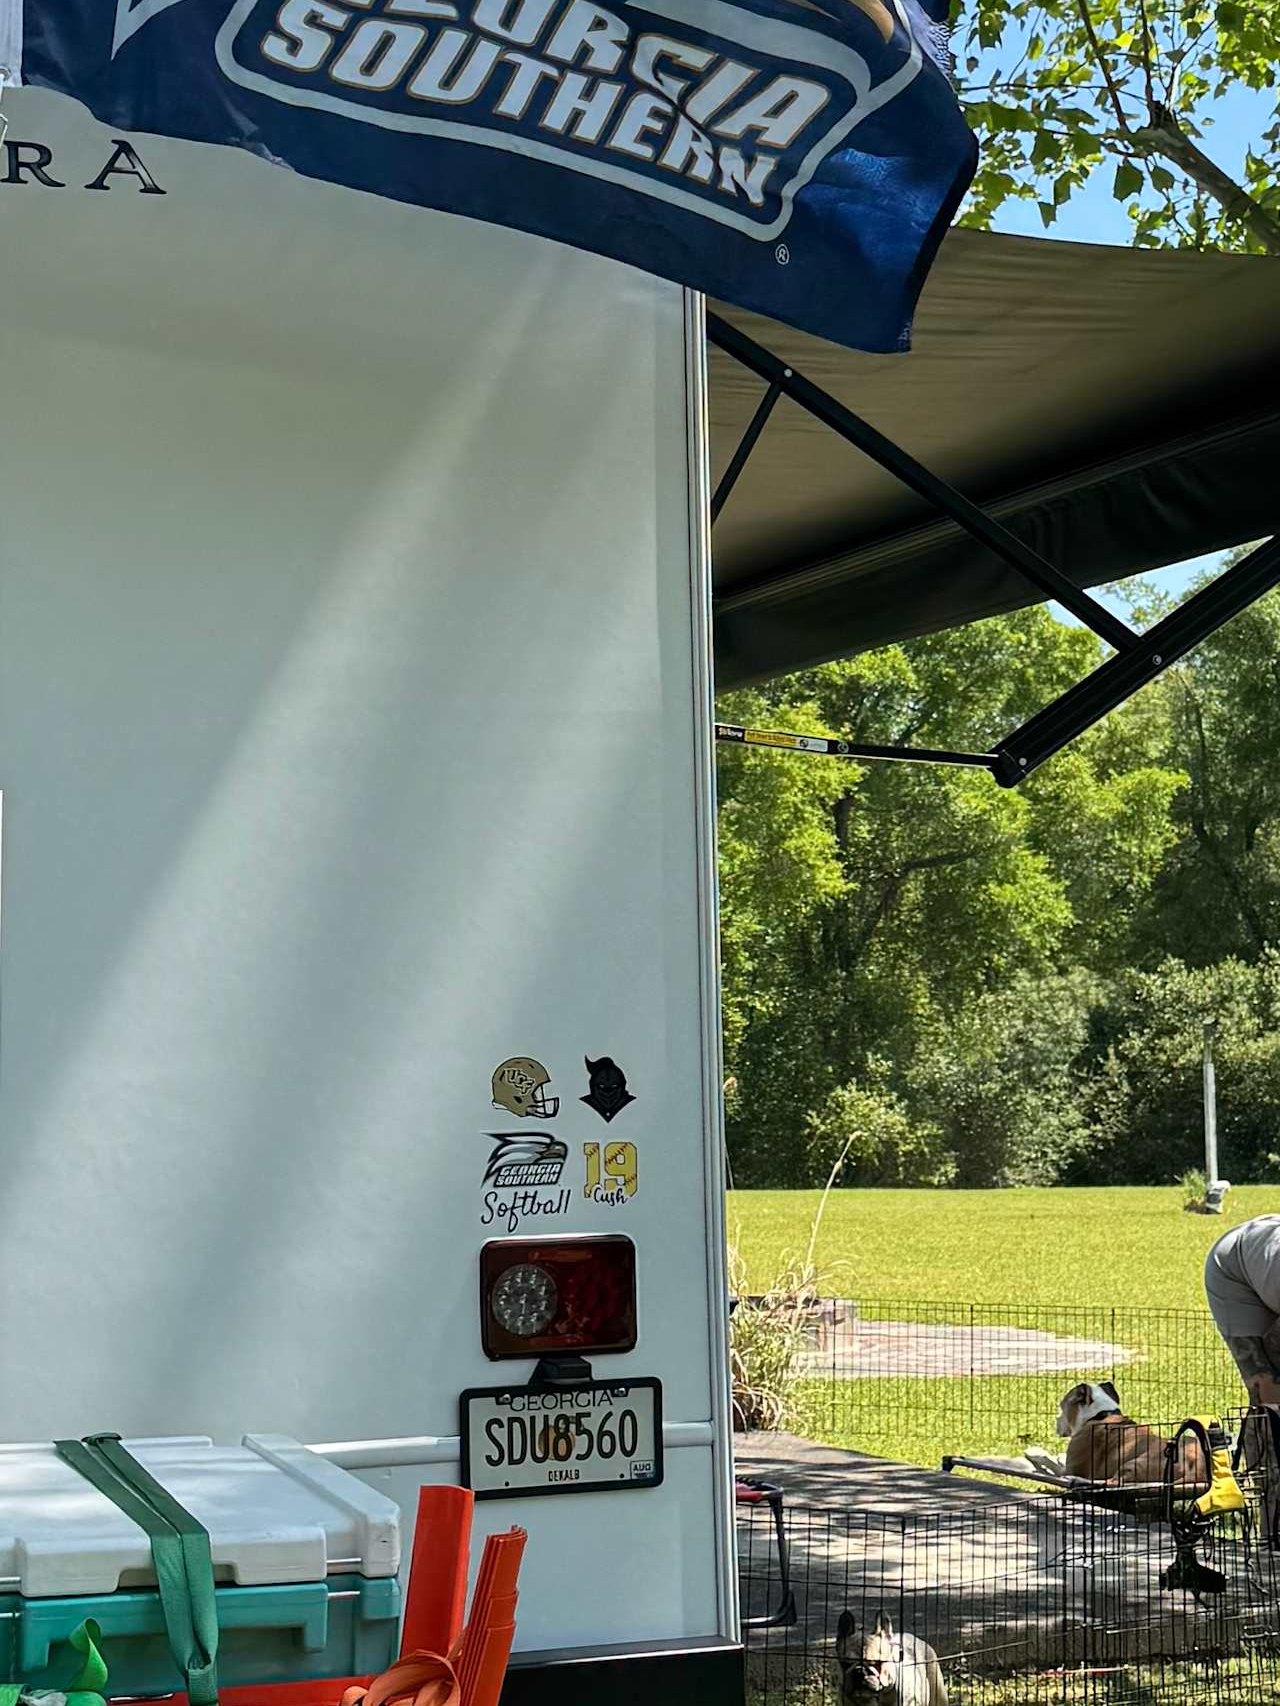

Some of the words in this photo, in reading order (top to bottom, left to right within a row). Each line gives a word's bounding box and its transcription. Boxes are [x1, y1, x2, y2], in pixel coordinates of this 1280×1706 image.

[500, 1162, 561, 1177] GEORGIA
[495, 1172, 558, 1186] SOUTHERN
[480, 1189, 571, 1233] Softball
[510, 1389, 614, 1411] GEORGIA
[484, 1409, 639, 1467] SDU8560
[548, 1469, 580, 1482] DEKALB
[632, 1463, 652, 1473] AUG
